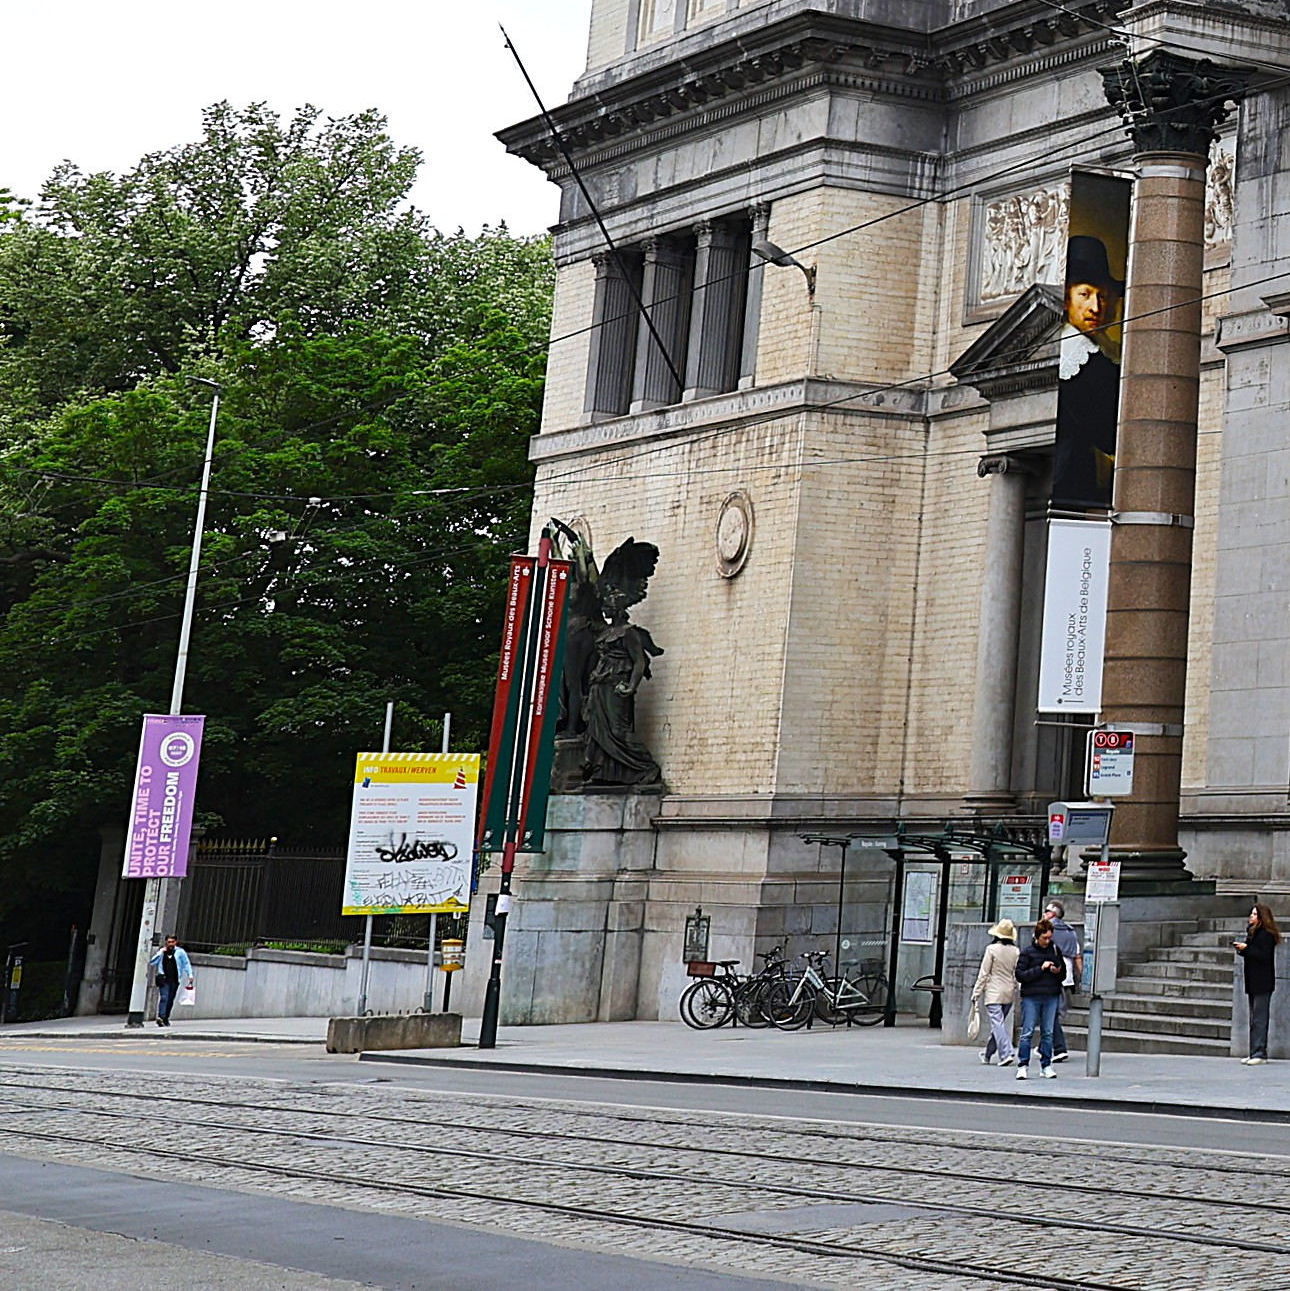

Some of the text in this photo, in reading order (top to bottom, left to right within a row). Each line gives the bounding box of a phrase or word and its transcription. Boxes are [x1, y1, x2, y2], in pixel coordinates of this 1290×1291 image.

[548, 569, 558, 599] Kunsten
[1080, 547, 1092, 595] Belgique
[507, 608, 516, 621] des
[545, 601, 555, 629] Schone
[1079, 599, 1088, 613] de
[504, 623, 514, 650] Royaux
[501, 652, 511, 680] Musées
[540, 649, 550, 673] Musea
[1062, 613, 1078, 695] Musées royaux
[536, 675, 547, 716] Koninklijke
[1074, 674, 1084, 696] des
[140, 766, 153, 785] TO
[135, 787, 151, 825] TIME
[160, 772, 180, 843] FREEDOM
[142, 809, 161, 877] PROTECT
[156, 845, 171, 876] OUR
